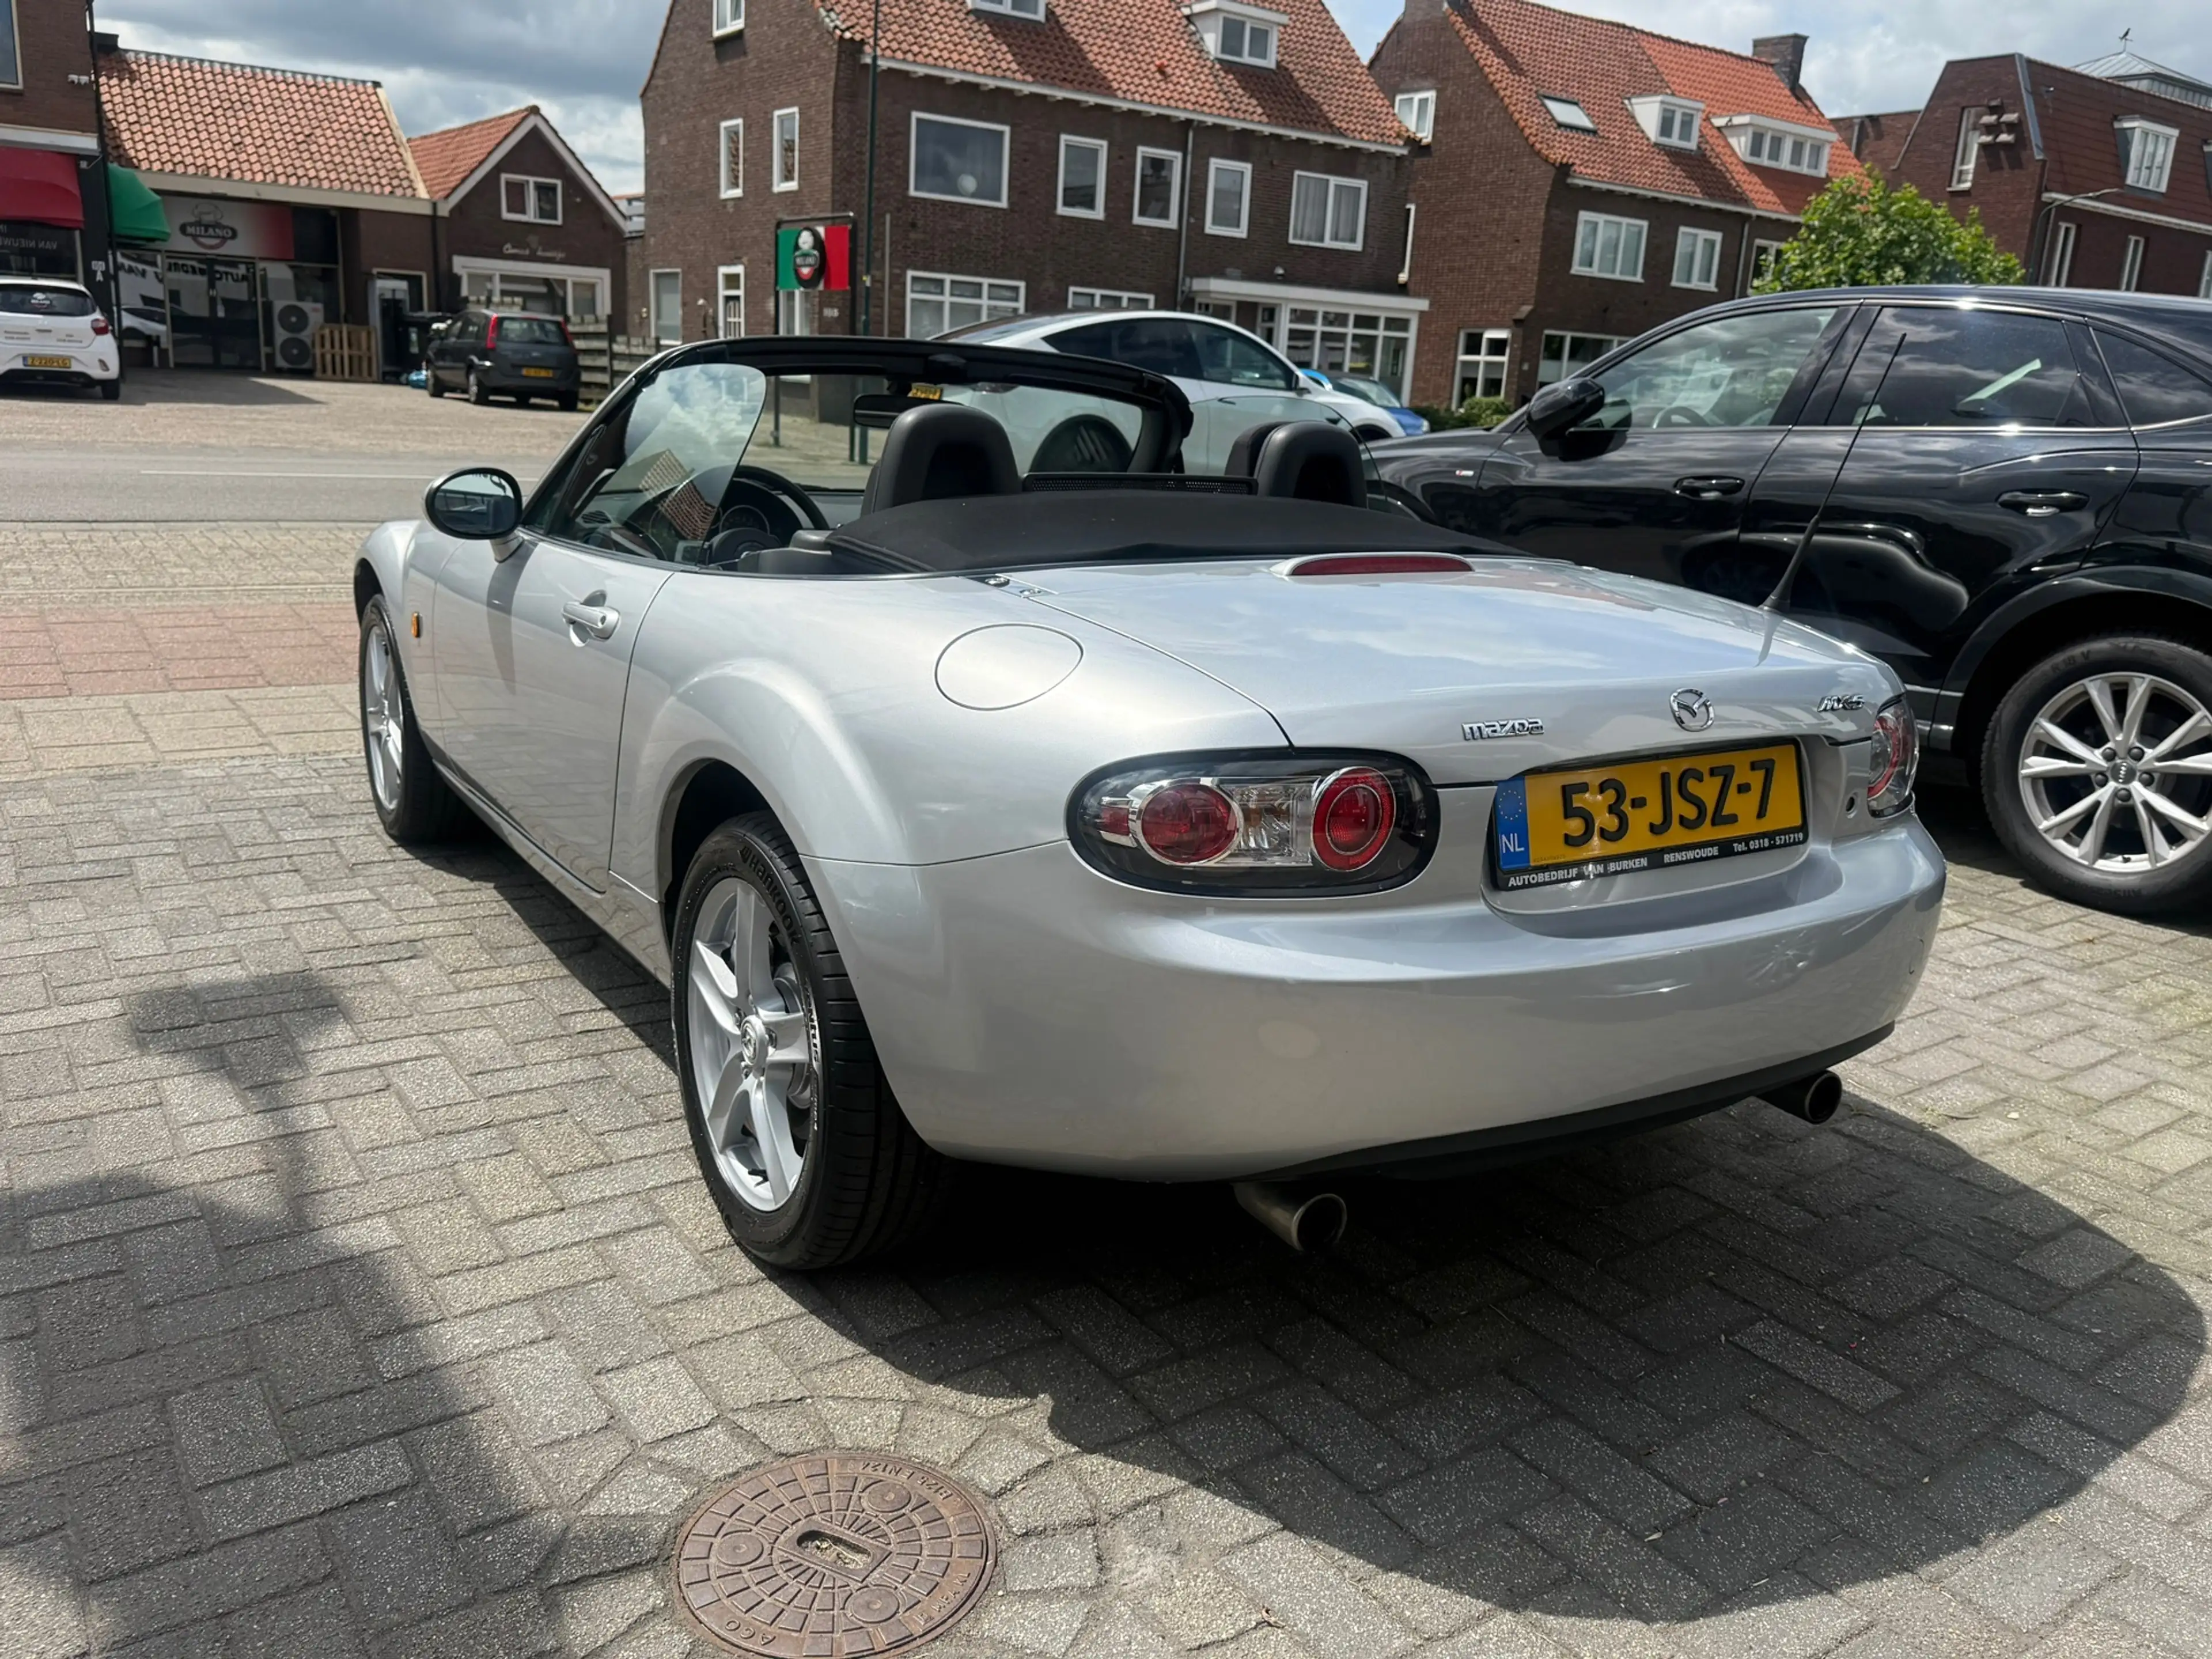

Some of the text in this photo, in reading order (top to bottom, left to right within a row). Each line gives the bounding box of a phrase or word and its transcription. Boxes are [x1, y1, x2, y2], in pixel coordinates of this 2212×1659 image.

[185, 225, 233, 238] MILANO
[1561, 757, 1777, 847] 53-JSZ-7
[1501, 832, 1525, 853] NL
[1508, 868, 1579, 888] AUTOBEDRIJF
[1584, 863, 1604, 876] VAN
[1609, 857, 1648, 872] BURKEN
[1663, 846, 1719, 863] RENSWOUDE
[1732, 843, 1748, 853] Tel.
[1749, 838, 1769, 850] 0318
[1775, 832, 1804, 846] 571719
[917, 1476, 953, 1501] B125
